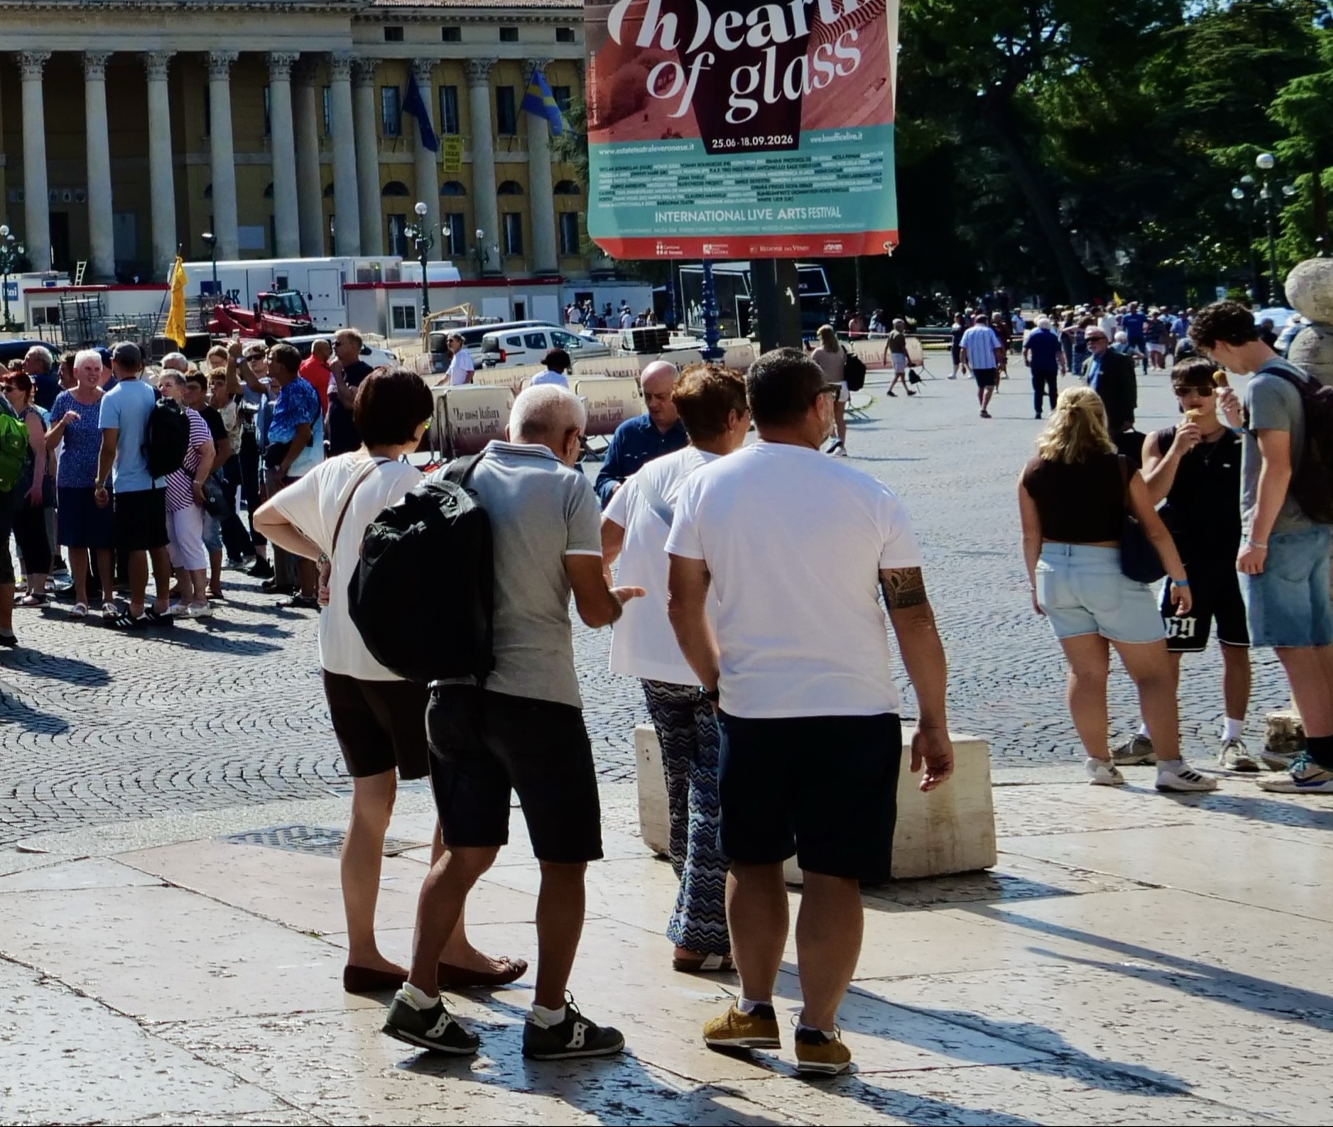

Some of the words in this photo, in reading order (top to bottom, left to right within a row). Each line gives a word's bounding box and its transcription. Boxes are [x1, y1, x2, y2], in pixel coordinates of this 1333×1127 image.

[646, 51, 715, 118] of
[725, 29, 862, 124] glass
[712, 138, 736, 149] 25.06
[741, 135, 794, 147] 18.09.2026
[655, 209, 746, 223] INTERNATIONAL
[748, 208, 773, 221] LIVE
[777, 207, 806, 220] ARTS
[808, 206, 842, 219] FESTIVAL
[465, 410, 478, 420] most
[478, 406, 500, 419] Italian
[1164, 616, 1197, 639] 69
